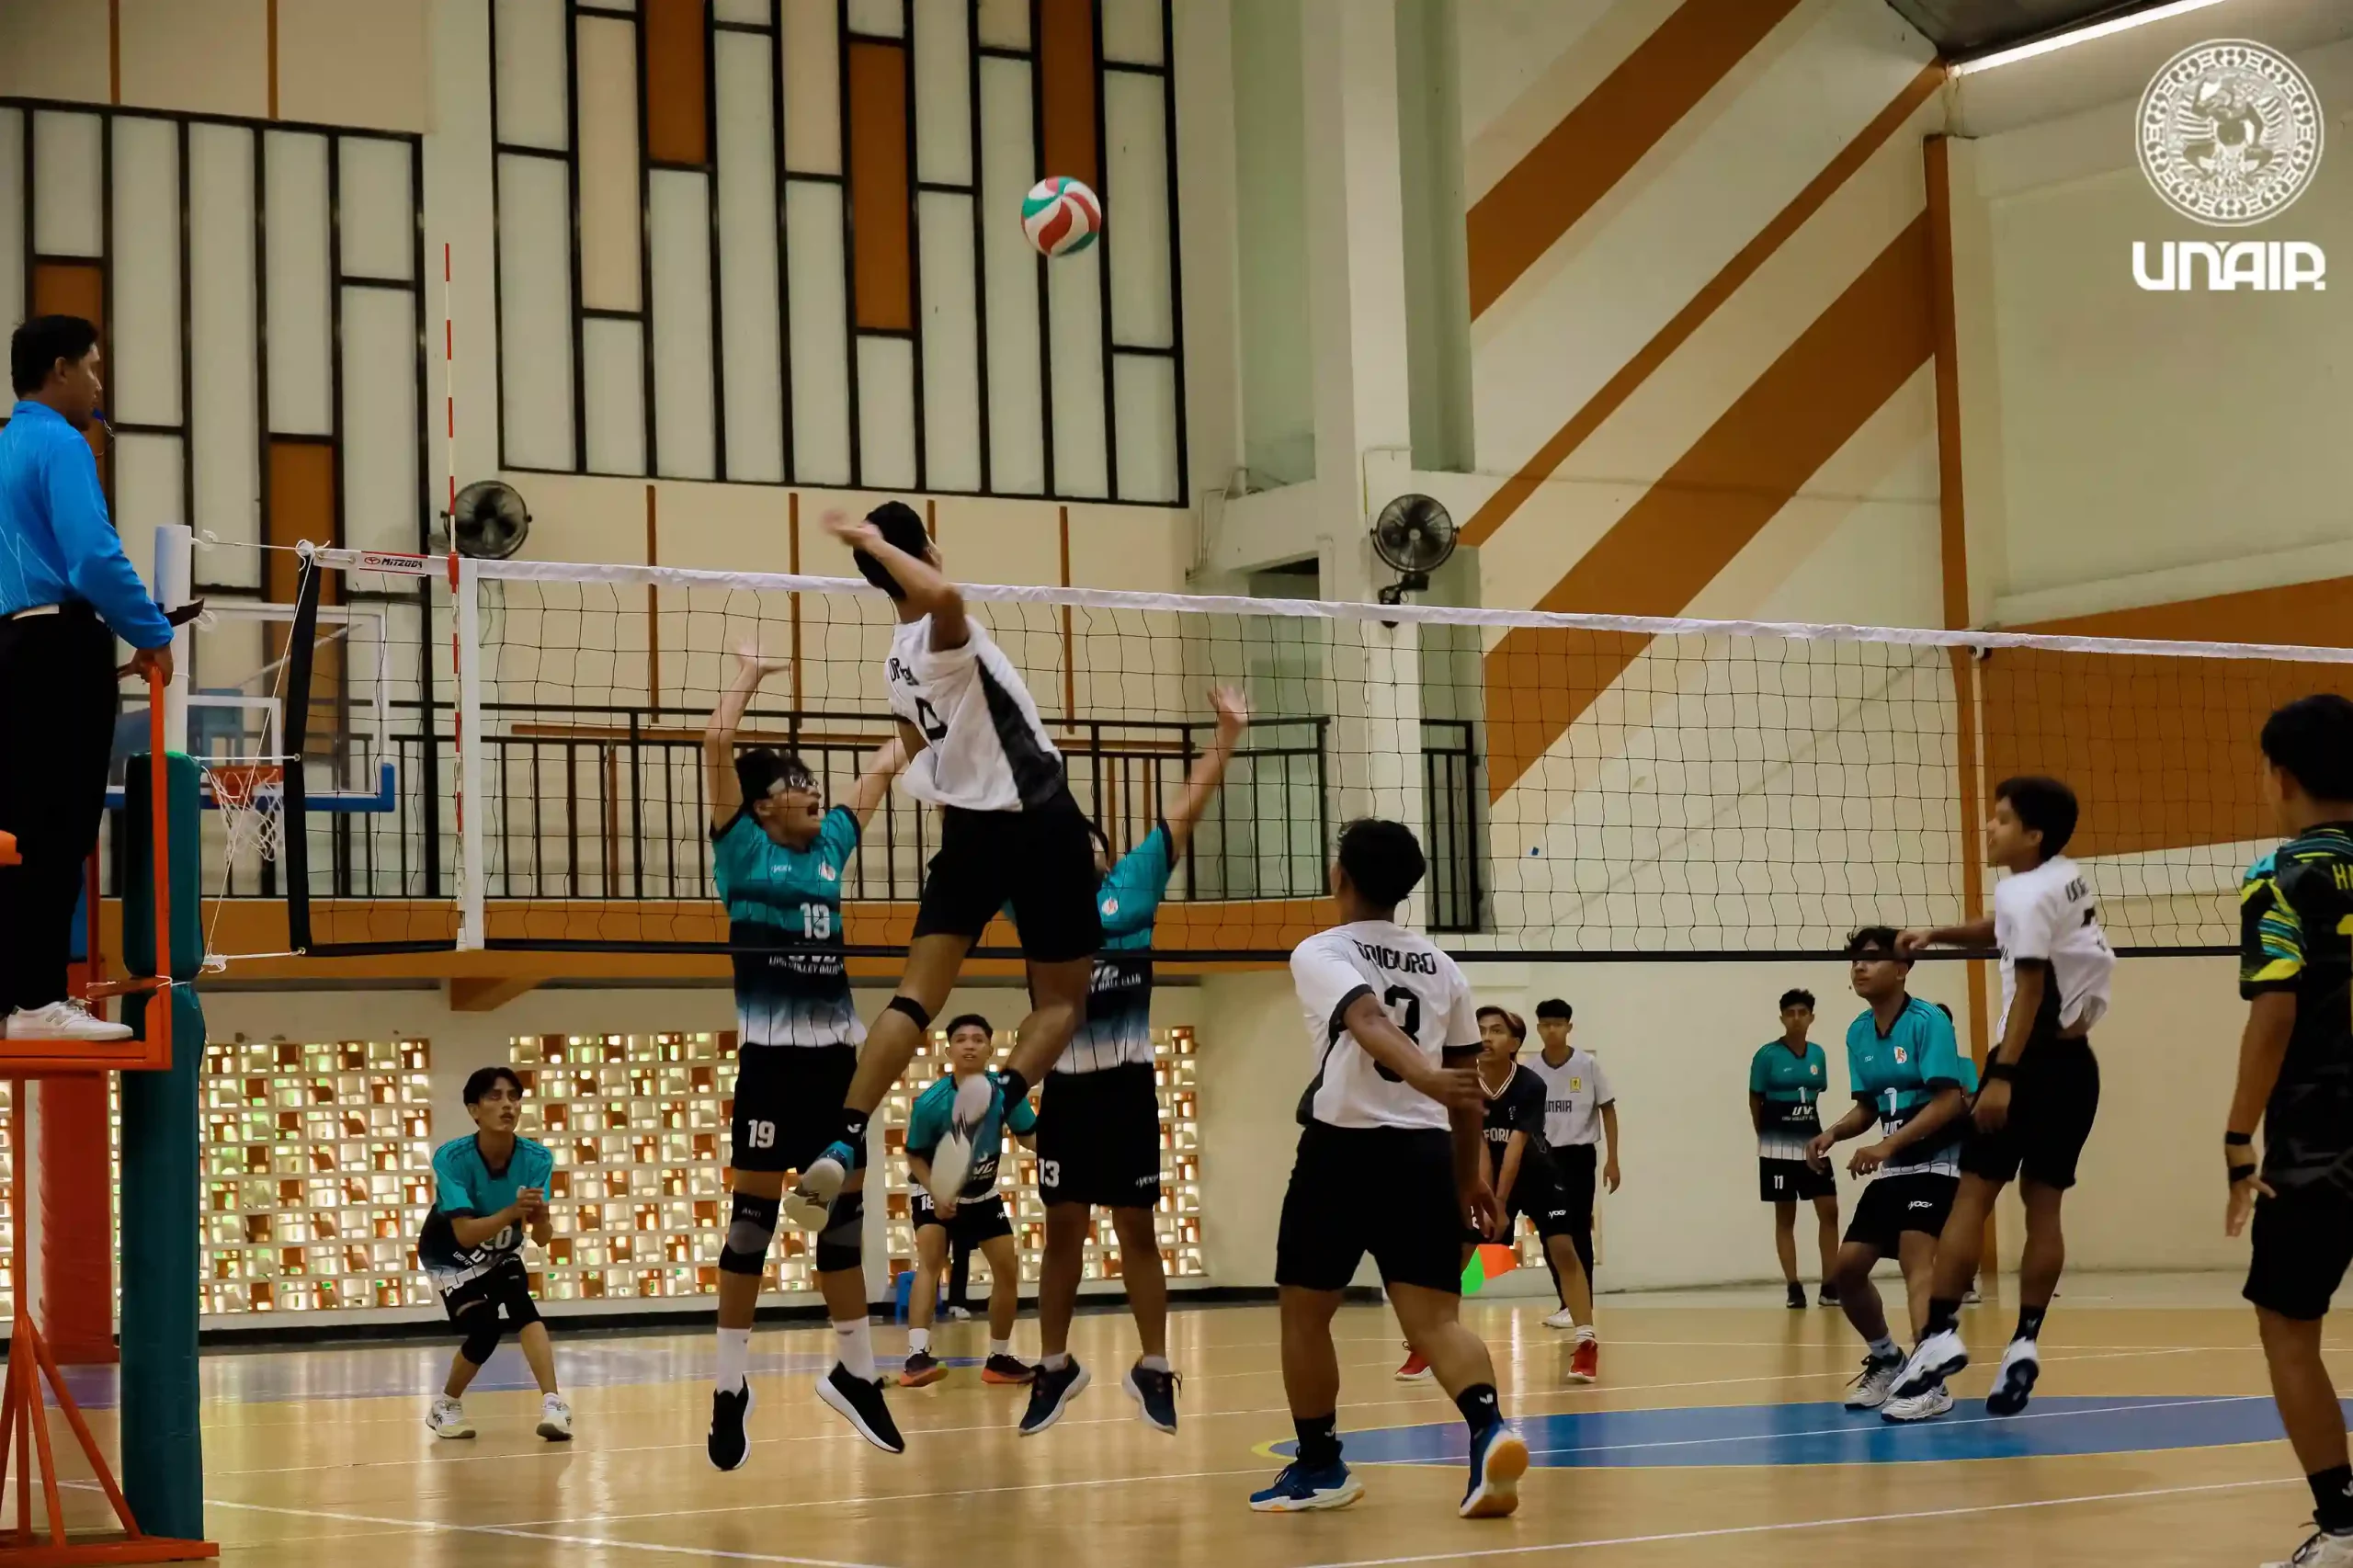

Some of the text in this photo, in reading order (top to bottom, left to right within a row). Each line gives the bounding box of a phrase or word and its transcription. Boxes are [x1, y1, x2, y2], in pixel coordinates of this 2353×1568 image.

[800, 902, 831, 939] 19
[748, 1119, 776, 1149] 19
[1038, 1157, 1060, 1187] 13
[1773, 1175, 1784, 1189] 11
